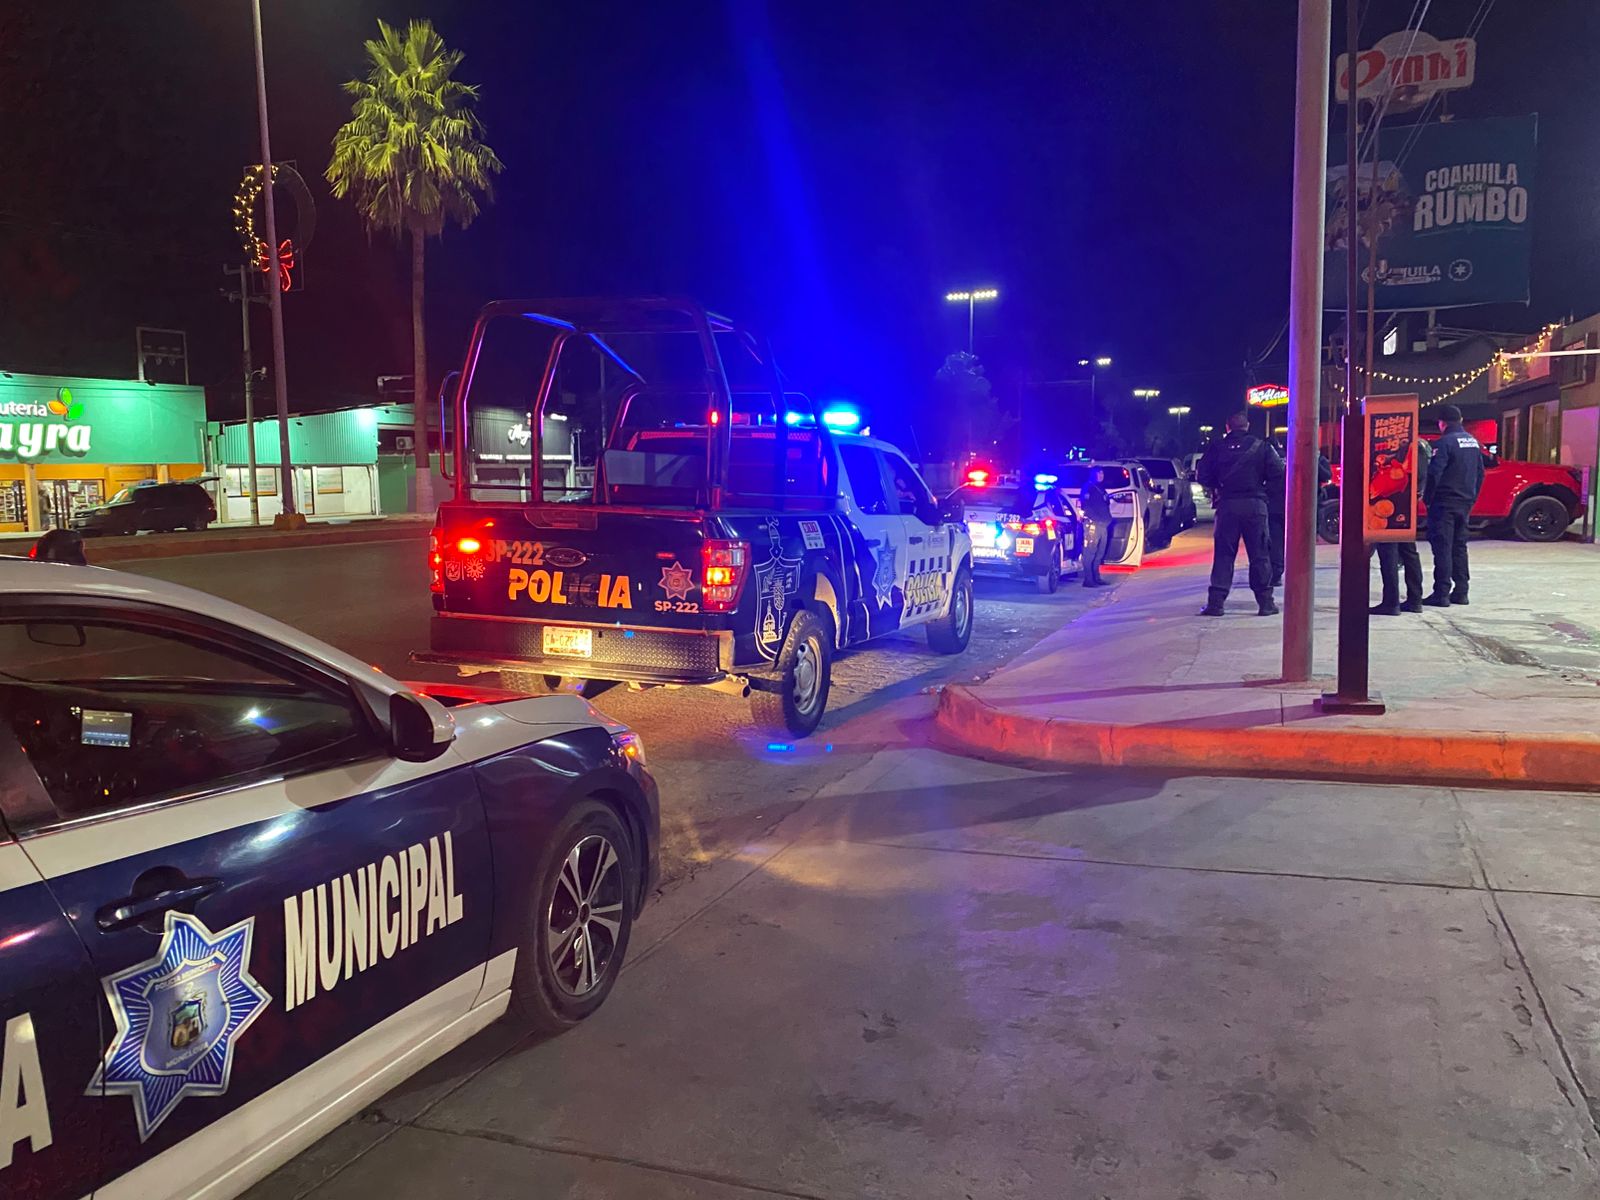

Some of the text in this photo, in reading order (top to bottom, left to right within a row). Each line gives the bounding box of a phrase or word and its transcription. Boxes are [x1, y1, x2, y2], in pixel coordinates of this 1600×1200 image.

[1425, 163, 1517, 192] COAHUILA
[1413, 187, 1528, 231] RUMBO
[486, 539, 543, 565] SP-222
[654, 600, 699, 613] SP-222
[283, 831, 463, 1012] MUNICIPAL
